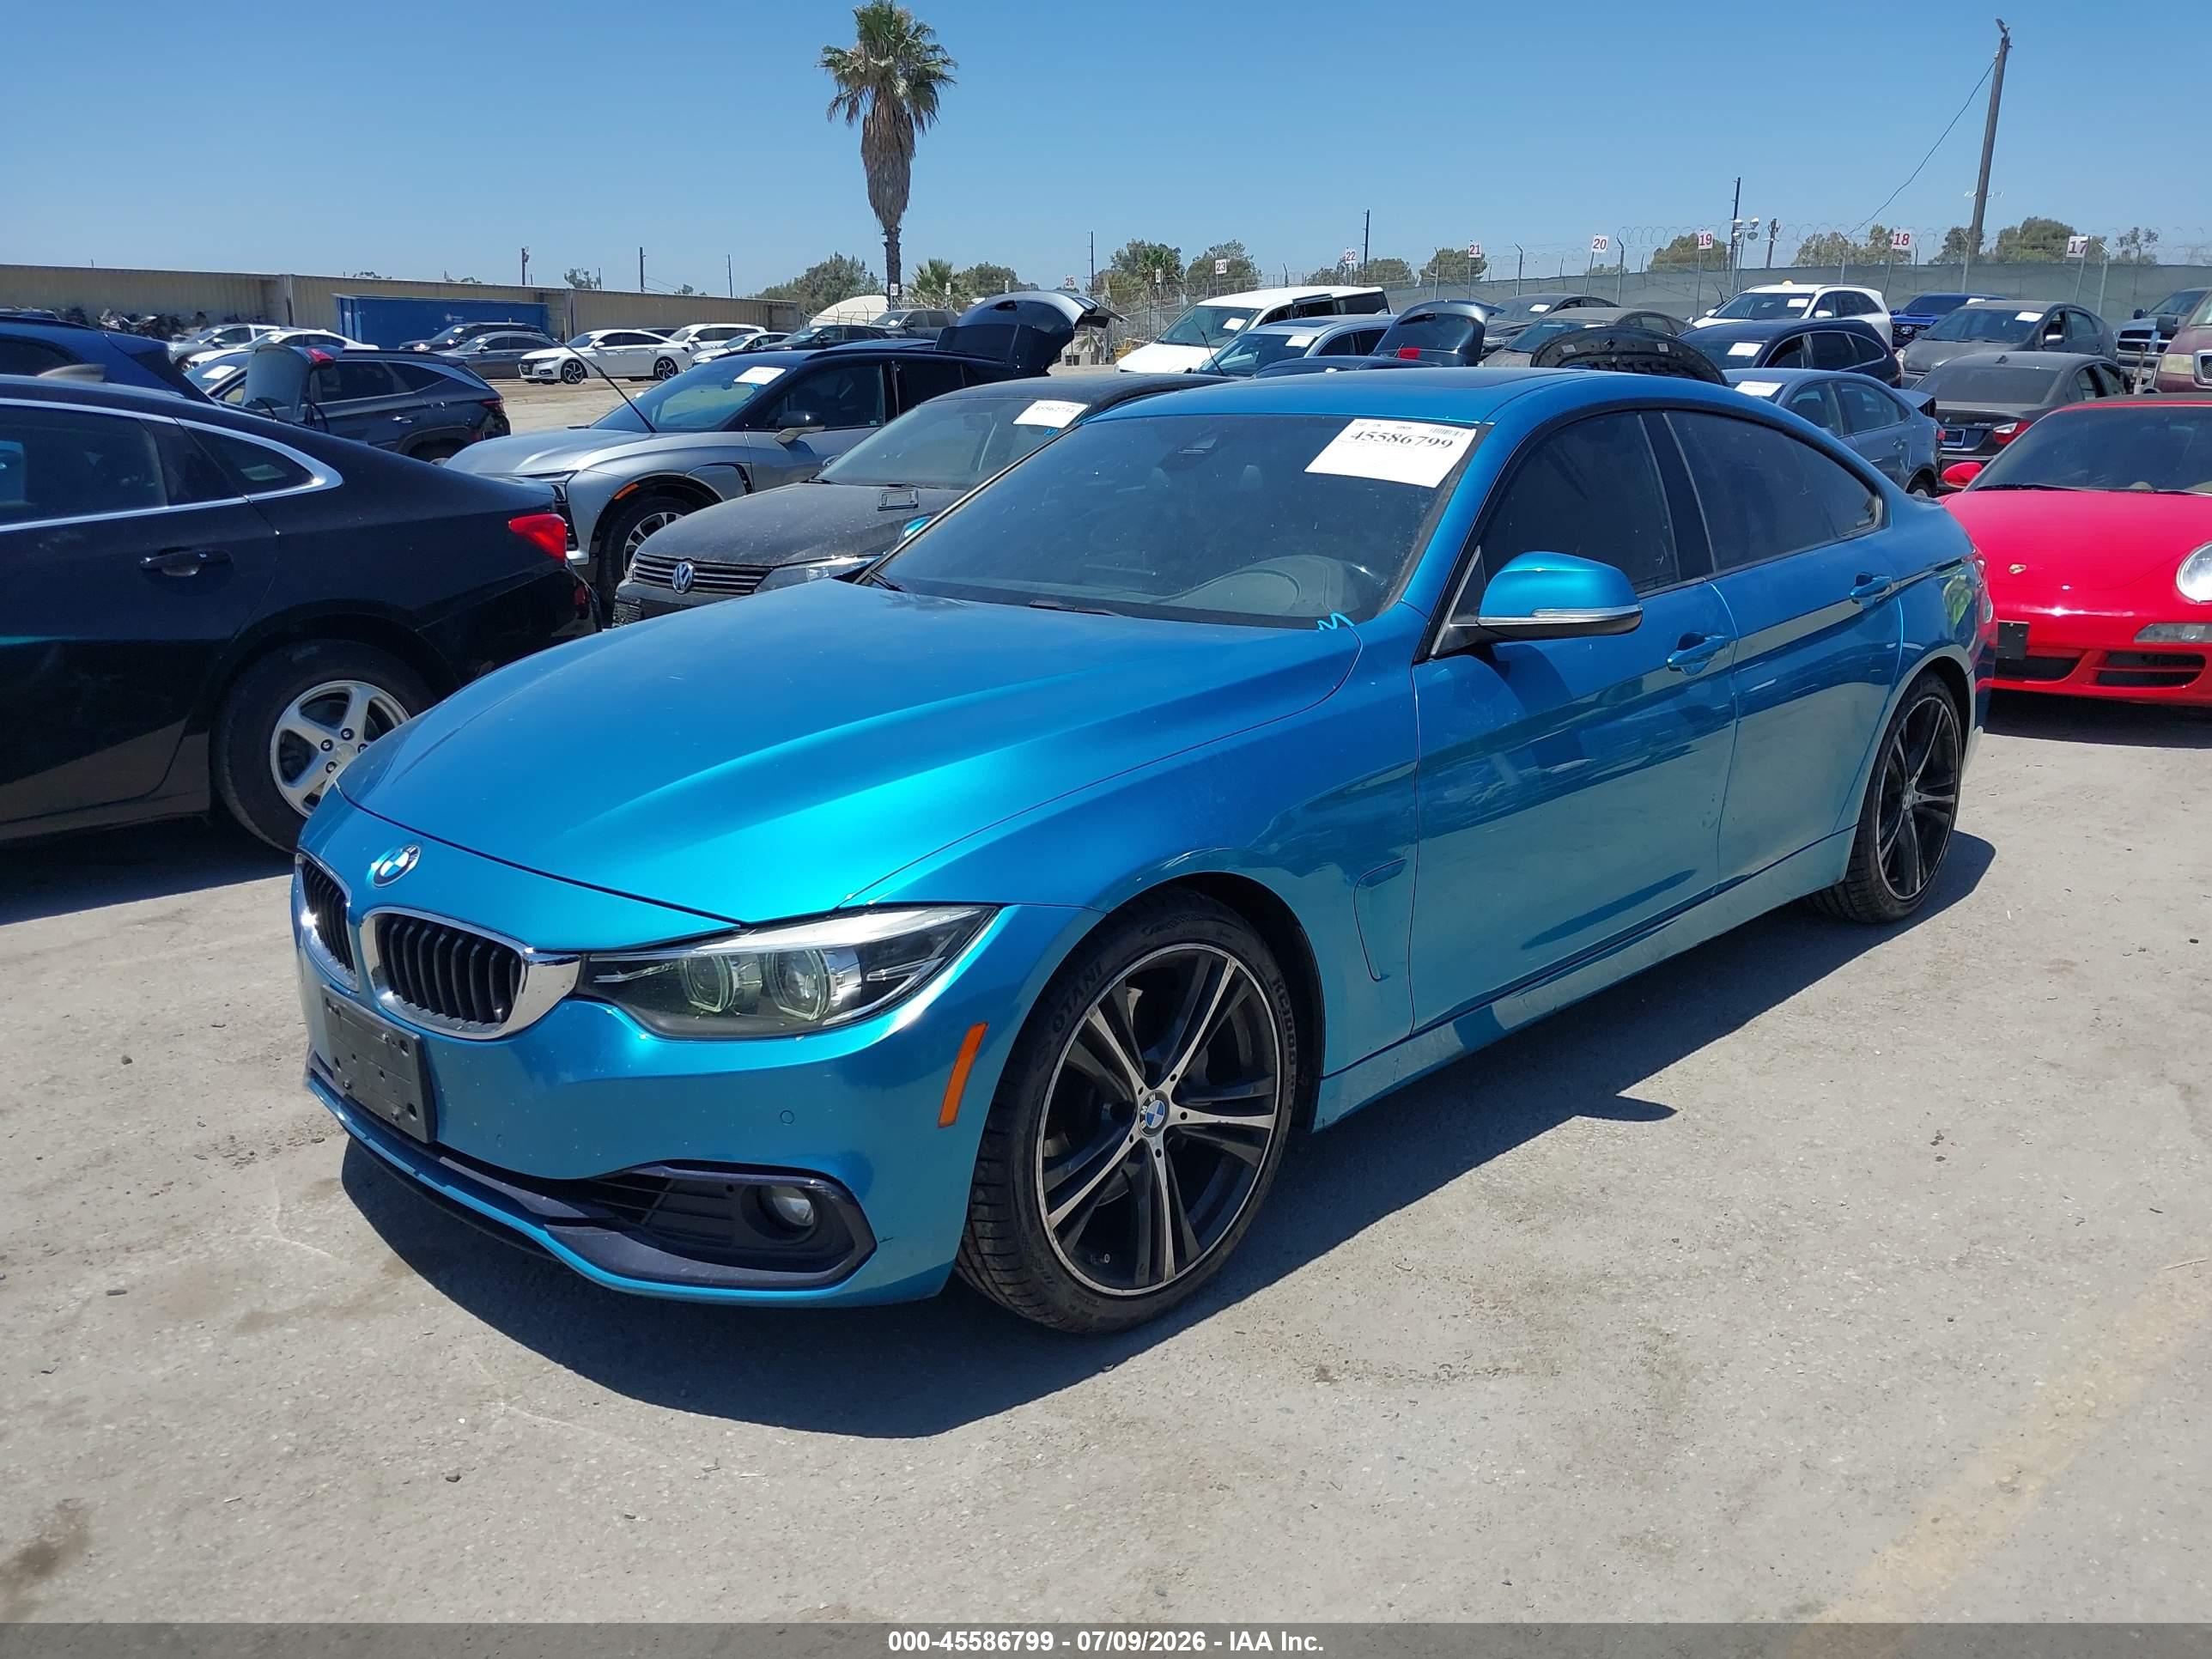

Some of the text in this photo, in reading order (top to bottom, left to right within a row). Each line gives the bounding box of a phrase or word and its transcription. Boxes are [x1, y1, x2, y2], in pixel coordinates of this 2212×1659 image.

[1592, 238, 1607, 250] 20
[1698, 233, 1712, 246] 19
[1893, 233, 1911, 246] 18
[1469, 244, 1481, 255] 21
[2068, 240, 2088, 254] 17
[1346, 251, 1356, 262] 22
[1216, 262, 1226, 272] 23
[1351, 430, 1454, 449] 45586799
